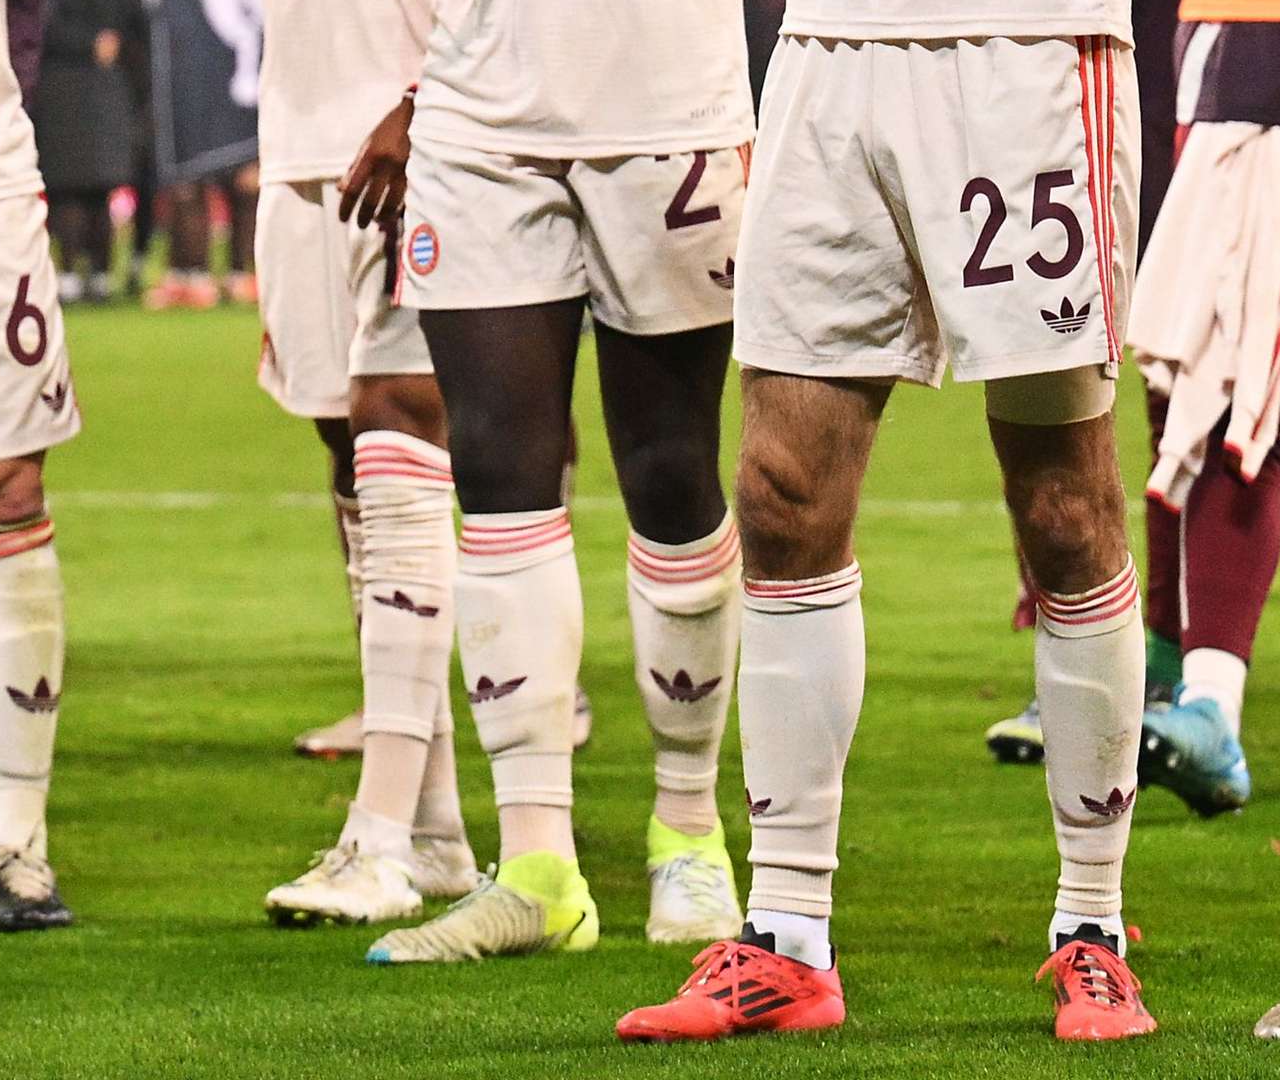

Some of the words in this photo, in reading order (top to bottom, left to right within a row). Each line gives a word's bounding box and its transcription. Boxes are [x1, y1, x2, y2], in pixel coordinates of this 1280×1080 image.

[654, 151, 721, 230] 2
[960, 170, 1084, 288] 25
[6, 274, 47, 367] 6
